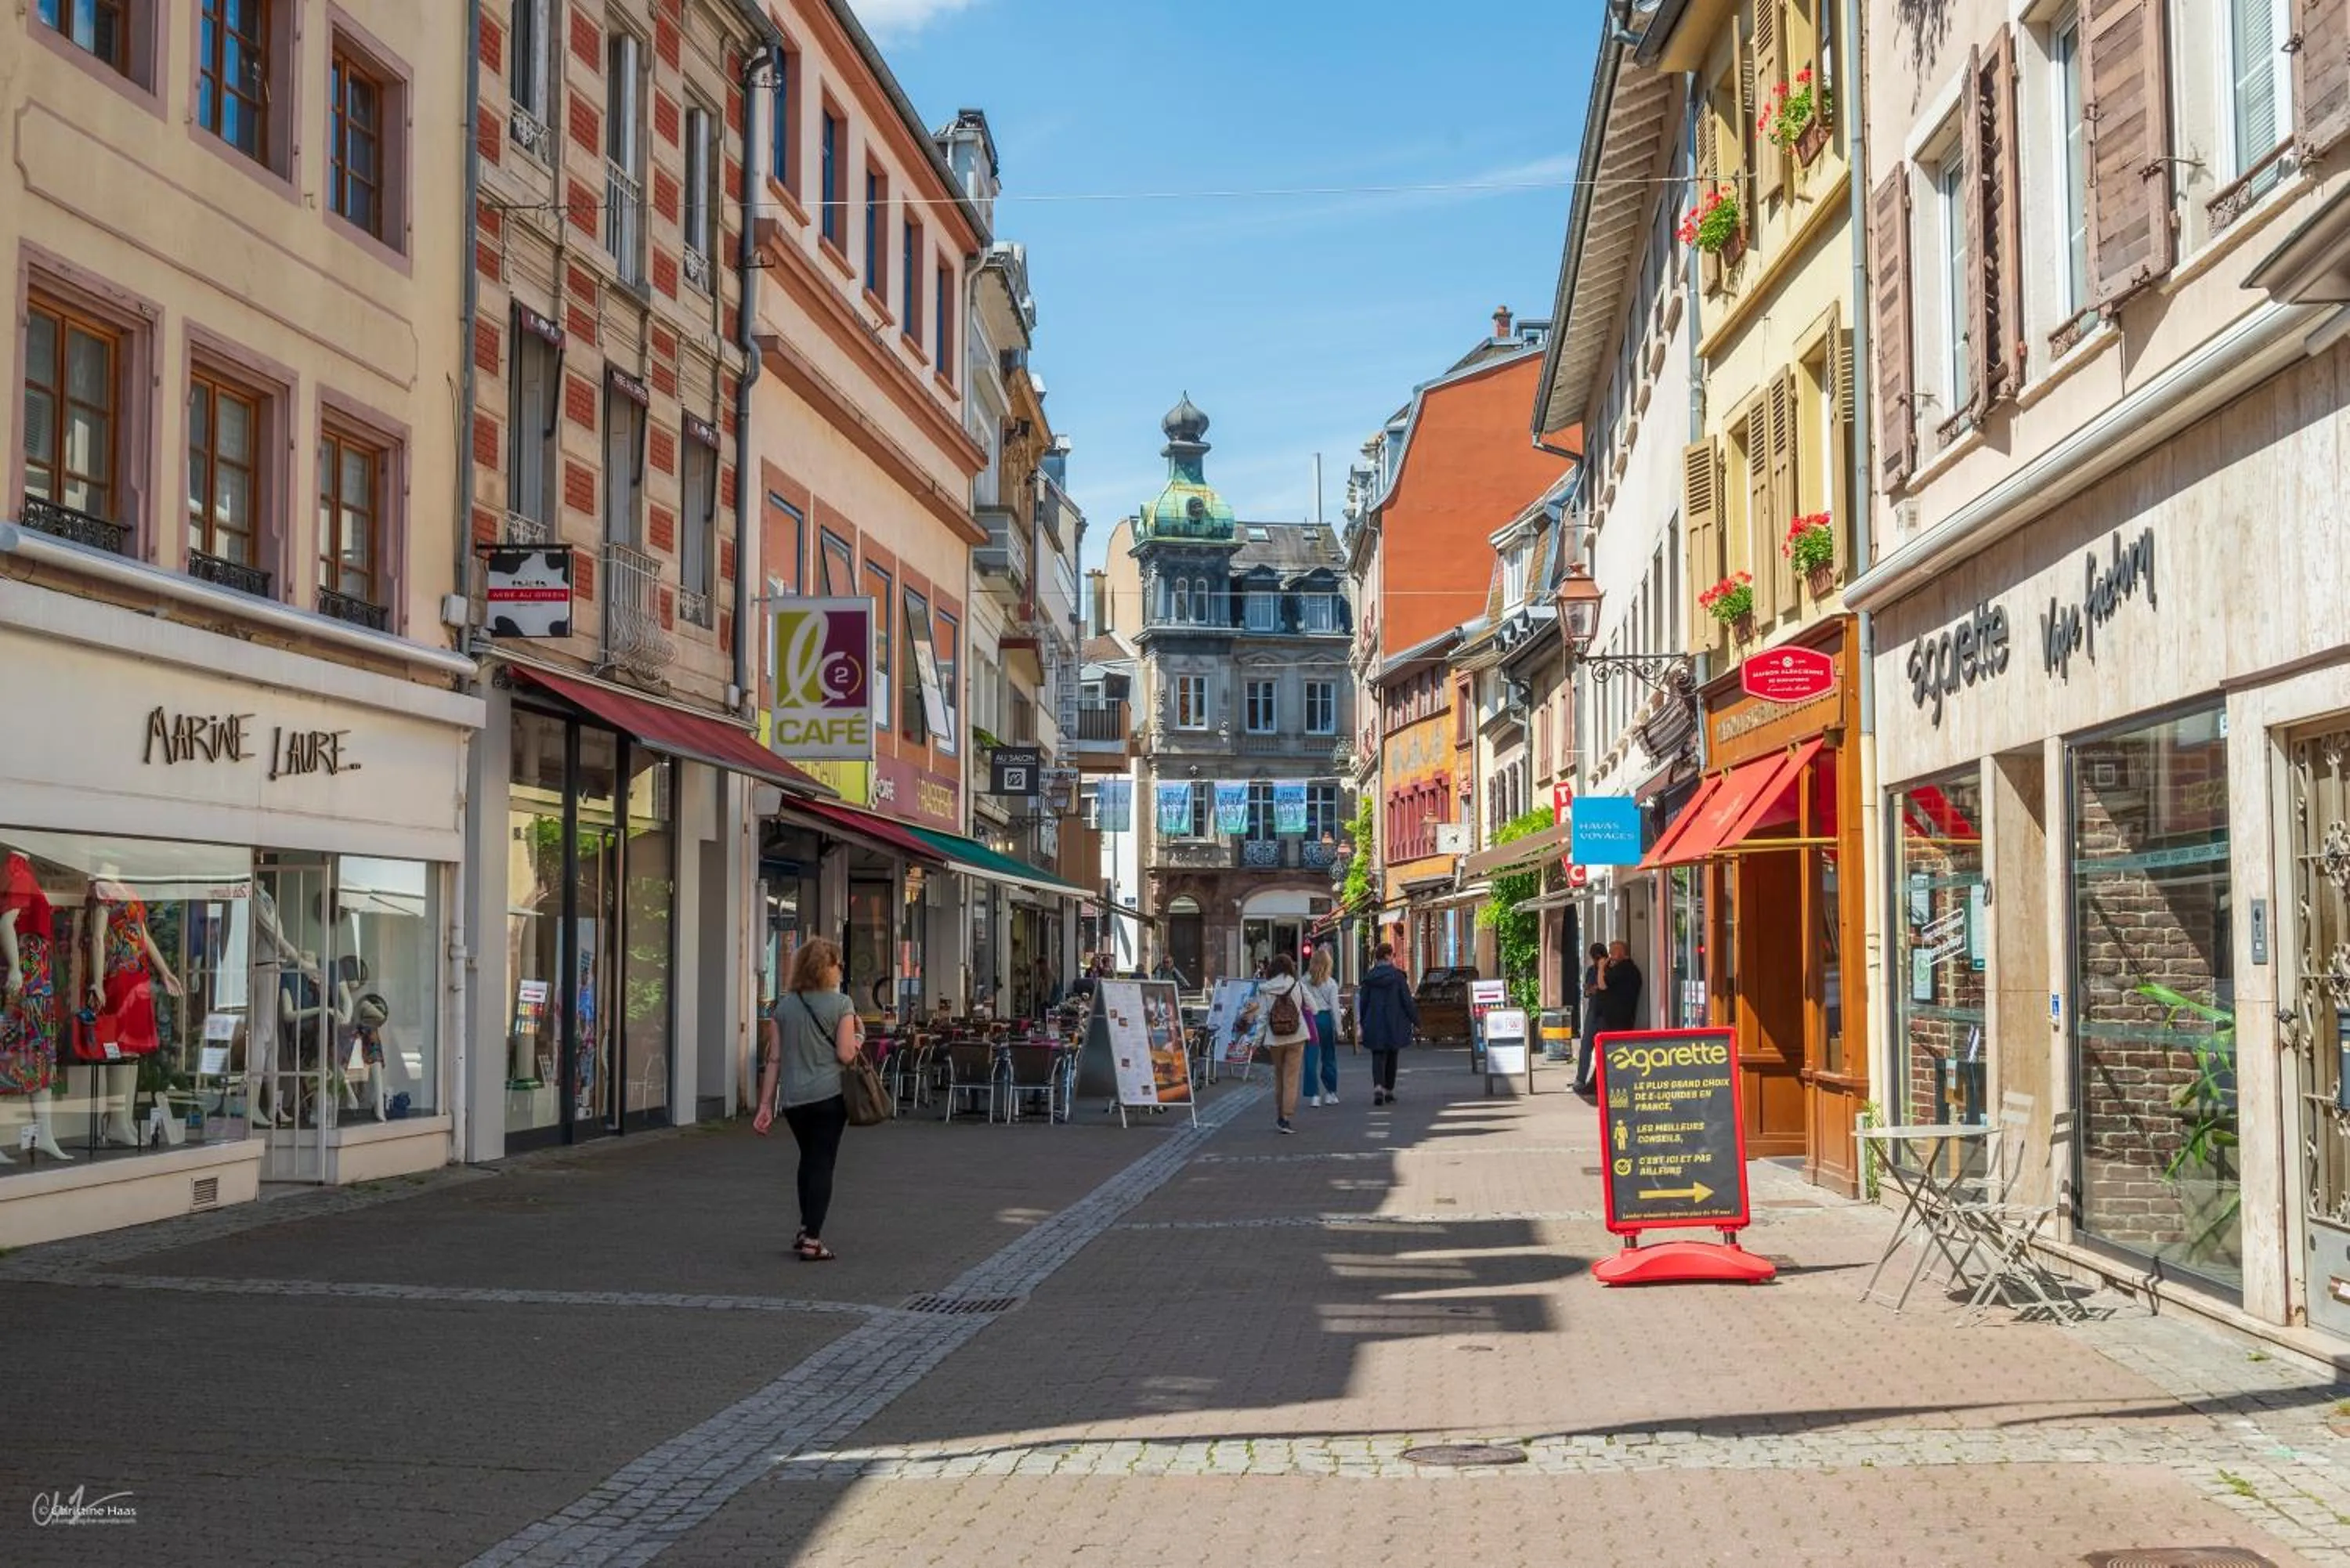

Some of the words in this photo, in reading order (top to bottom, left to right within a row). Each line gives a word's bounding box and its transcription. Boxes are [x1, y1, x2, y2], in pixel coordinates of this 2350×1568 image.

[776, 713, 868, 746] CAFÉ
[995, 753, 1007, 762] AU
[1008, 753, 1036, 763] SALON
[1579, 822, 1620, 830] HAVAS
[1634, 1082, 1644, 1091] LE
[1646, 1080, 1669, 1089] PLUS
[1671, 1078, 1701, 1089] GRAND
[1702, 1078, 1730, 1087] CHOIX
[1635, 1093, 1648, 1101] DE
[1699, 1089, 1712, 1098] EN
[1637, 1124, 1654, 1133] LES
[1655, 1122, 1705, 1133] MEILLEURS
[1680, 1154, 1693, 1163] ET
[1694, 1153, 1712, 1163] PAS
